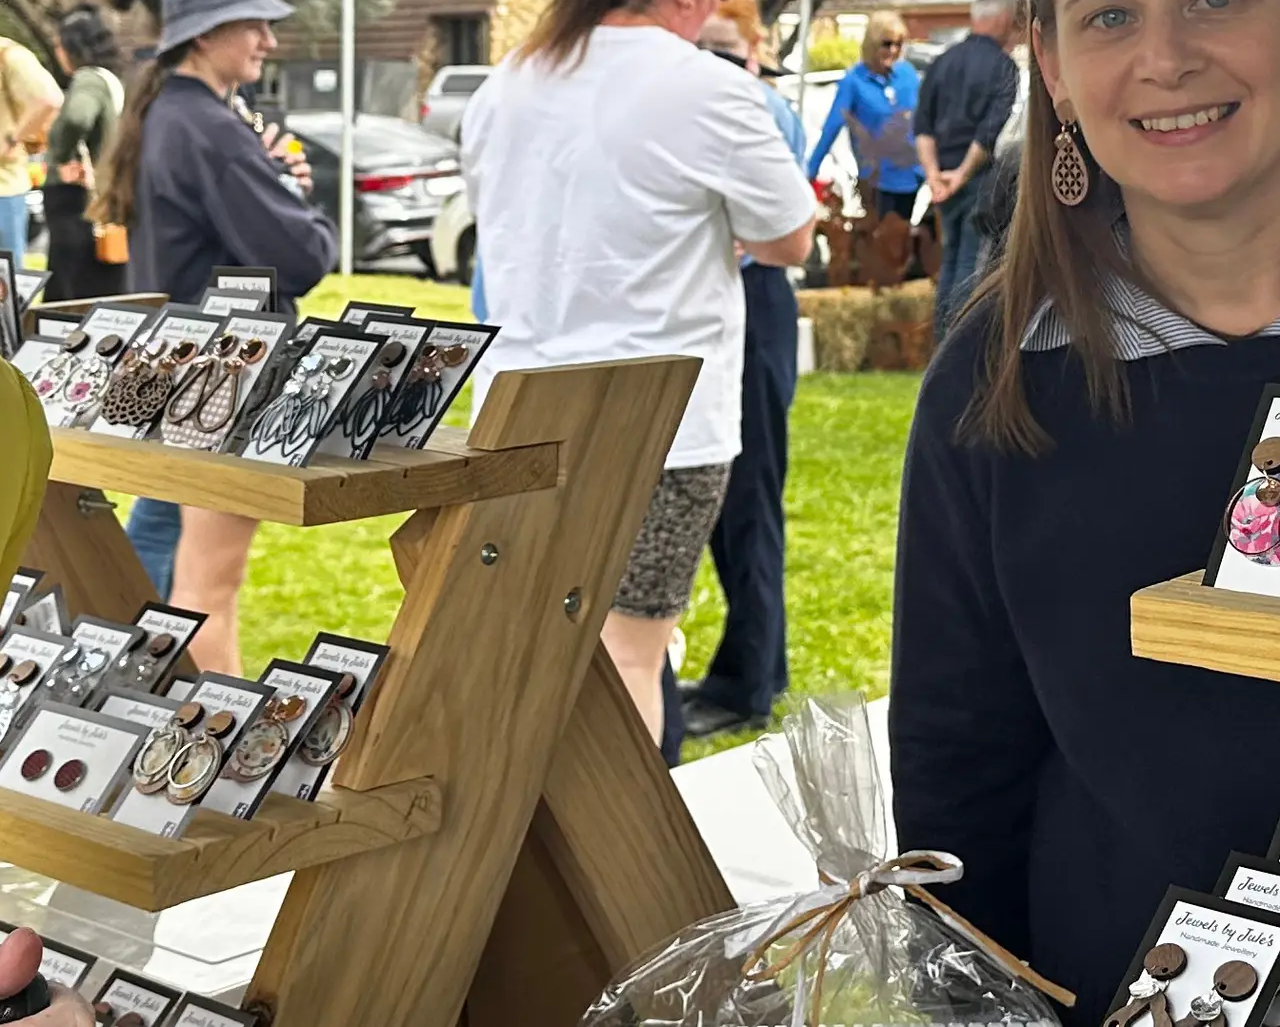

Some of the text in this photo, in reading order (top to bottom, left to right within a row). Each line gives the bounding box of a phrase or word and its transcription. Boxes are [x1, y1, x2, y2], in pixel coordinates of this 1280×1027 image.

[1238, 876, 1279, 897] Jewels
[1175, 911, 1275, 947] Jewels by Jule's
[1180, 931, 1258, 959] Handmade Jewellery
